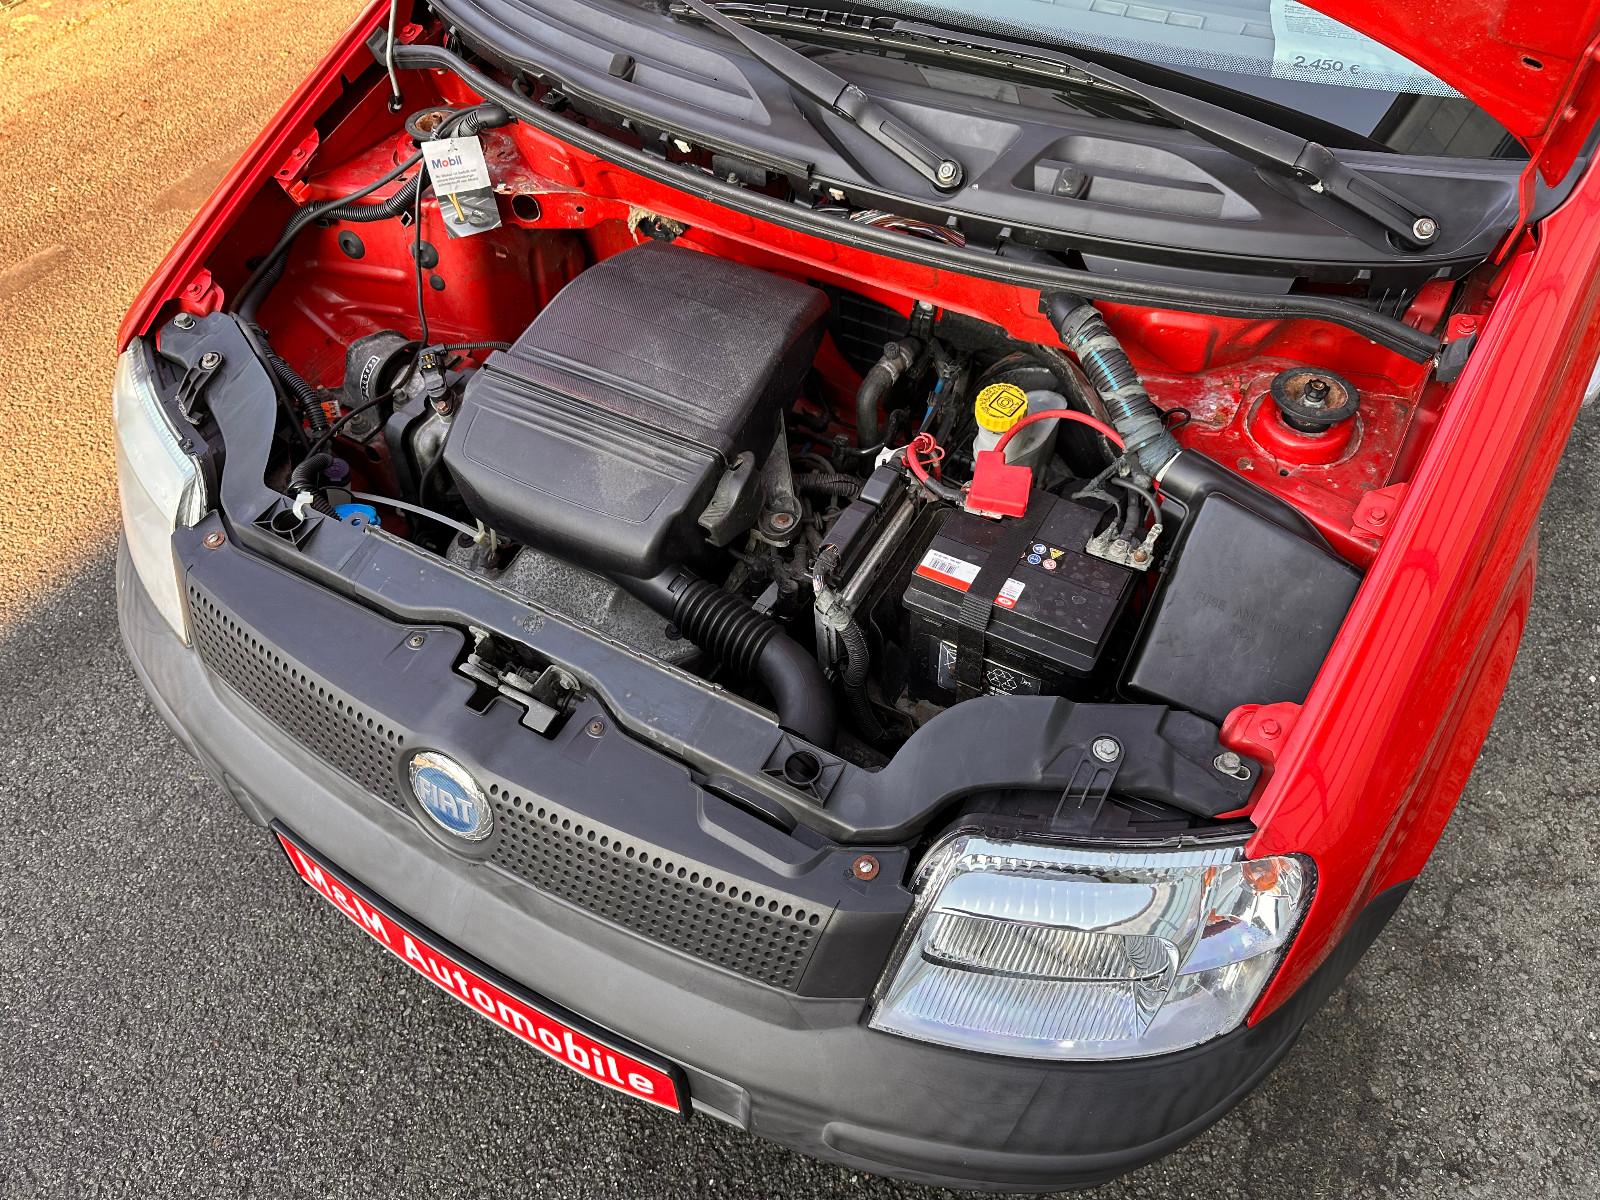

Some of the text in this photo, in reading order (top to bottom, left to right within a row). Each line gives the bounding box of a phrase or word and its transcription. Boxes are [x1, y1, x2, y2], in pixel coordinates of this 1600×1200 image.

[1293, 55, 1360, 75] 2.450 €
[431, 156, 462, 169] Mobil
[419, 775, 475, 824] FIAT
[295, 849, 655, 1096] M&M Automobile
